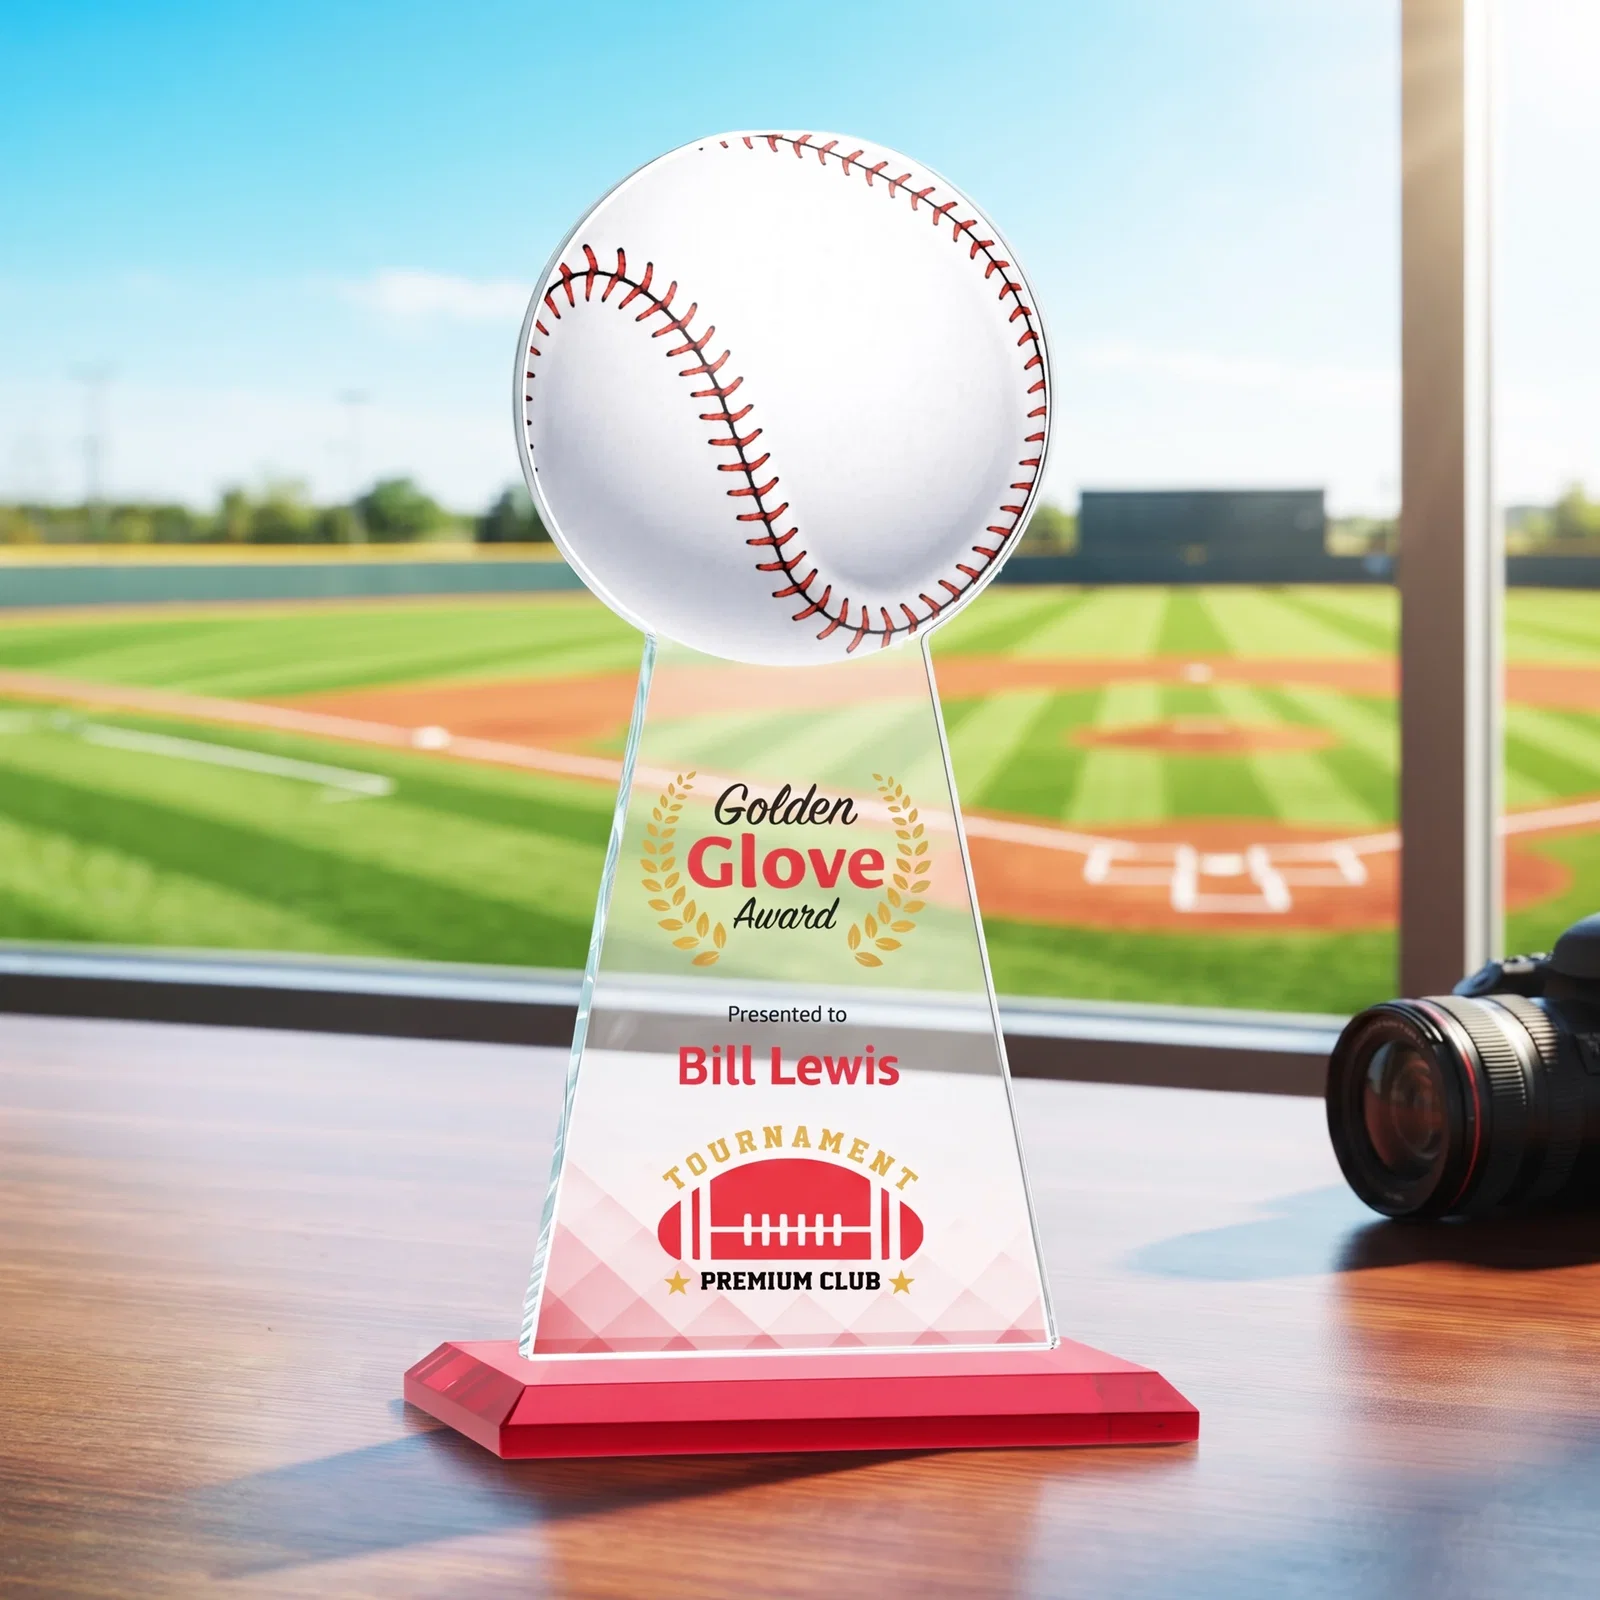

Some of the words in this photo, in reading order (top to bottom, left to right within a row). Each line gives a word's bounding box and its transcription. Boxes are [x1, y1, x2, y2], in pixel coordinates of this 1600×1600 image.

[714, 783, 858, 825] Golden
[687, 833, 885, 889] Glove
[733, 896, 841, 930] Award
[728, 1005, 822, 1023] Presented
[828, 1008, 847, 1023] to
[679, 1044, 756, 1086] Bill
[770, 1044, 900, 1086] Lewis
[662, 1125, 919, 1191] TOURNAMENT
[700, 1271, 813, 1291] PREMIUM
[819, 1271, 881, 1291] CLUB
